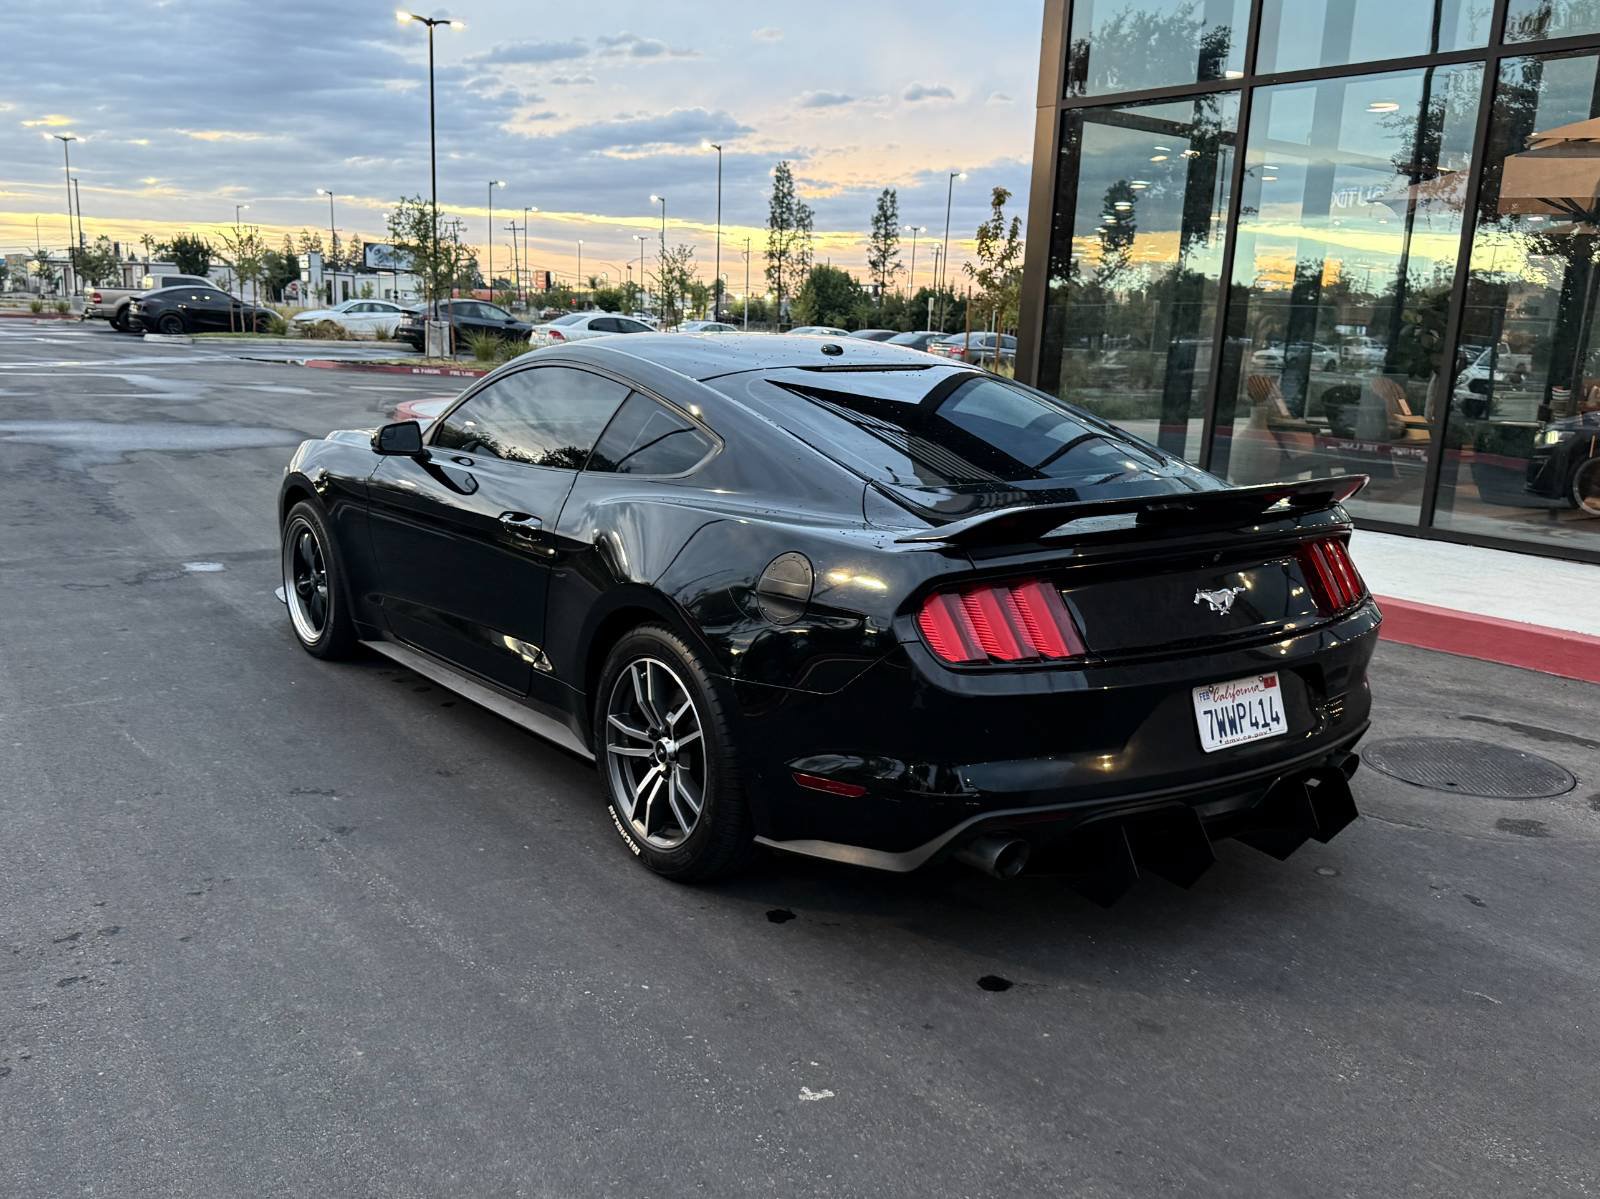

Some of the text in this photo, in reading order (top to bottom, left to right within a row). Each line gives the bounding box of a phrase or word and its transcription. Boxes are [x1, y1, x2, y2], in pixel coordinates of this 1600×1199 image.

[1213, 683, 1264, 703] California
[1203, 696, 1280, 740] 7WWP414
[608, 804, 641, 856] MICHELIN
